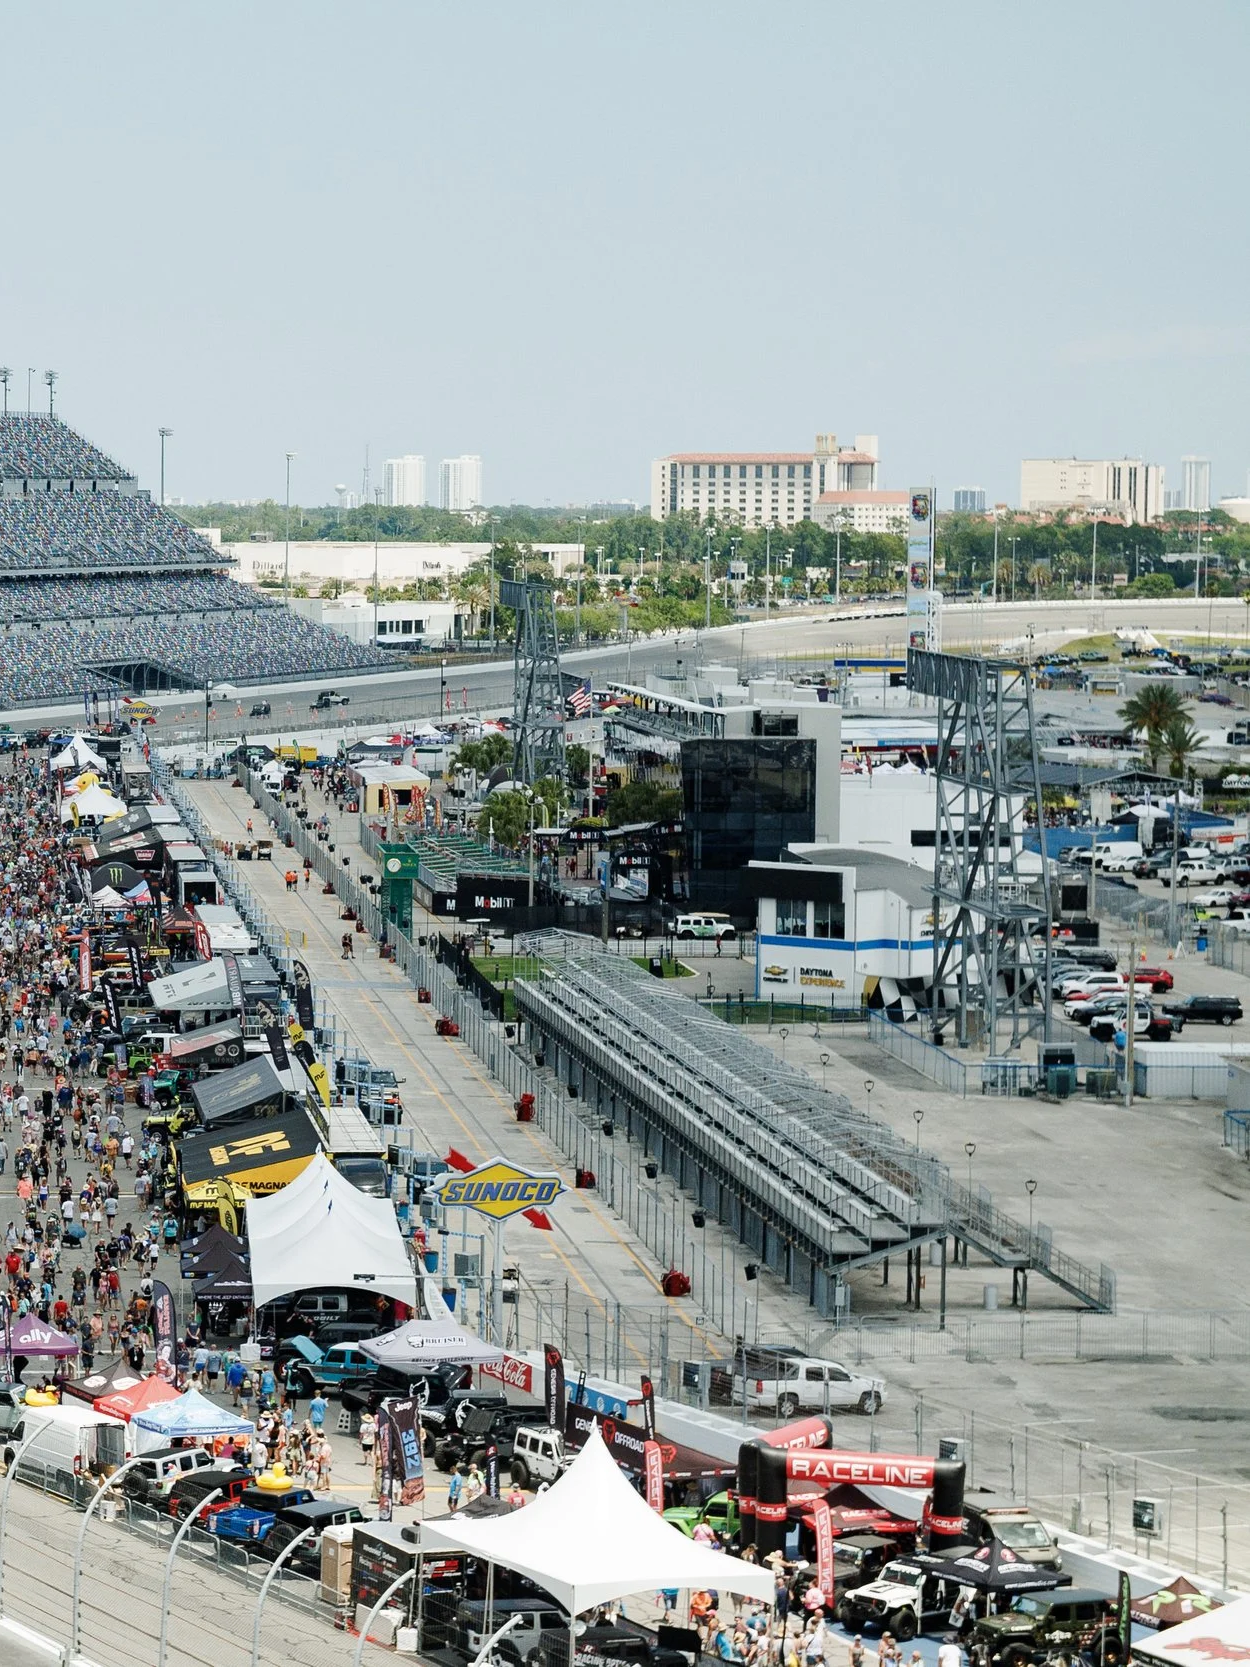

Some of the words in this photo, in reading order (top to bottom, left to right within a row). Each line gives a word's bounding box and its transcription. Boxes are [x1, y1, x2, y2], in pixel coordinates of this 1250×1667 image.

[619, 857, 641, 865] Mobil
[475, 896, 502, 909] Mobil
[800, 967, 833, 978] DAYTONA
[800, 976, 845, 988] EXPERIENCE
[250, 1182, 291, 1190] MAGNA
[445, 1182, 557, 1201] SUNOCO
[19, 1328, 52, 1344] ally
[395, 1401, 413, 1412] Jeep
[401, 1430, 421, 1469] 392
[615, 1433, 645, 1453] OFFROAD
[791, 1459, 930, 1485] RACELINE
